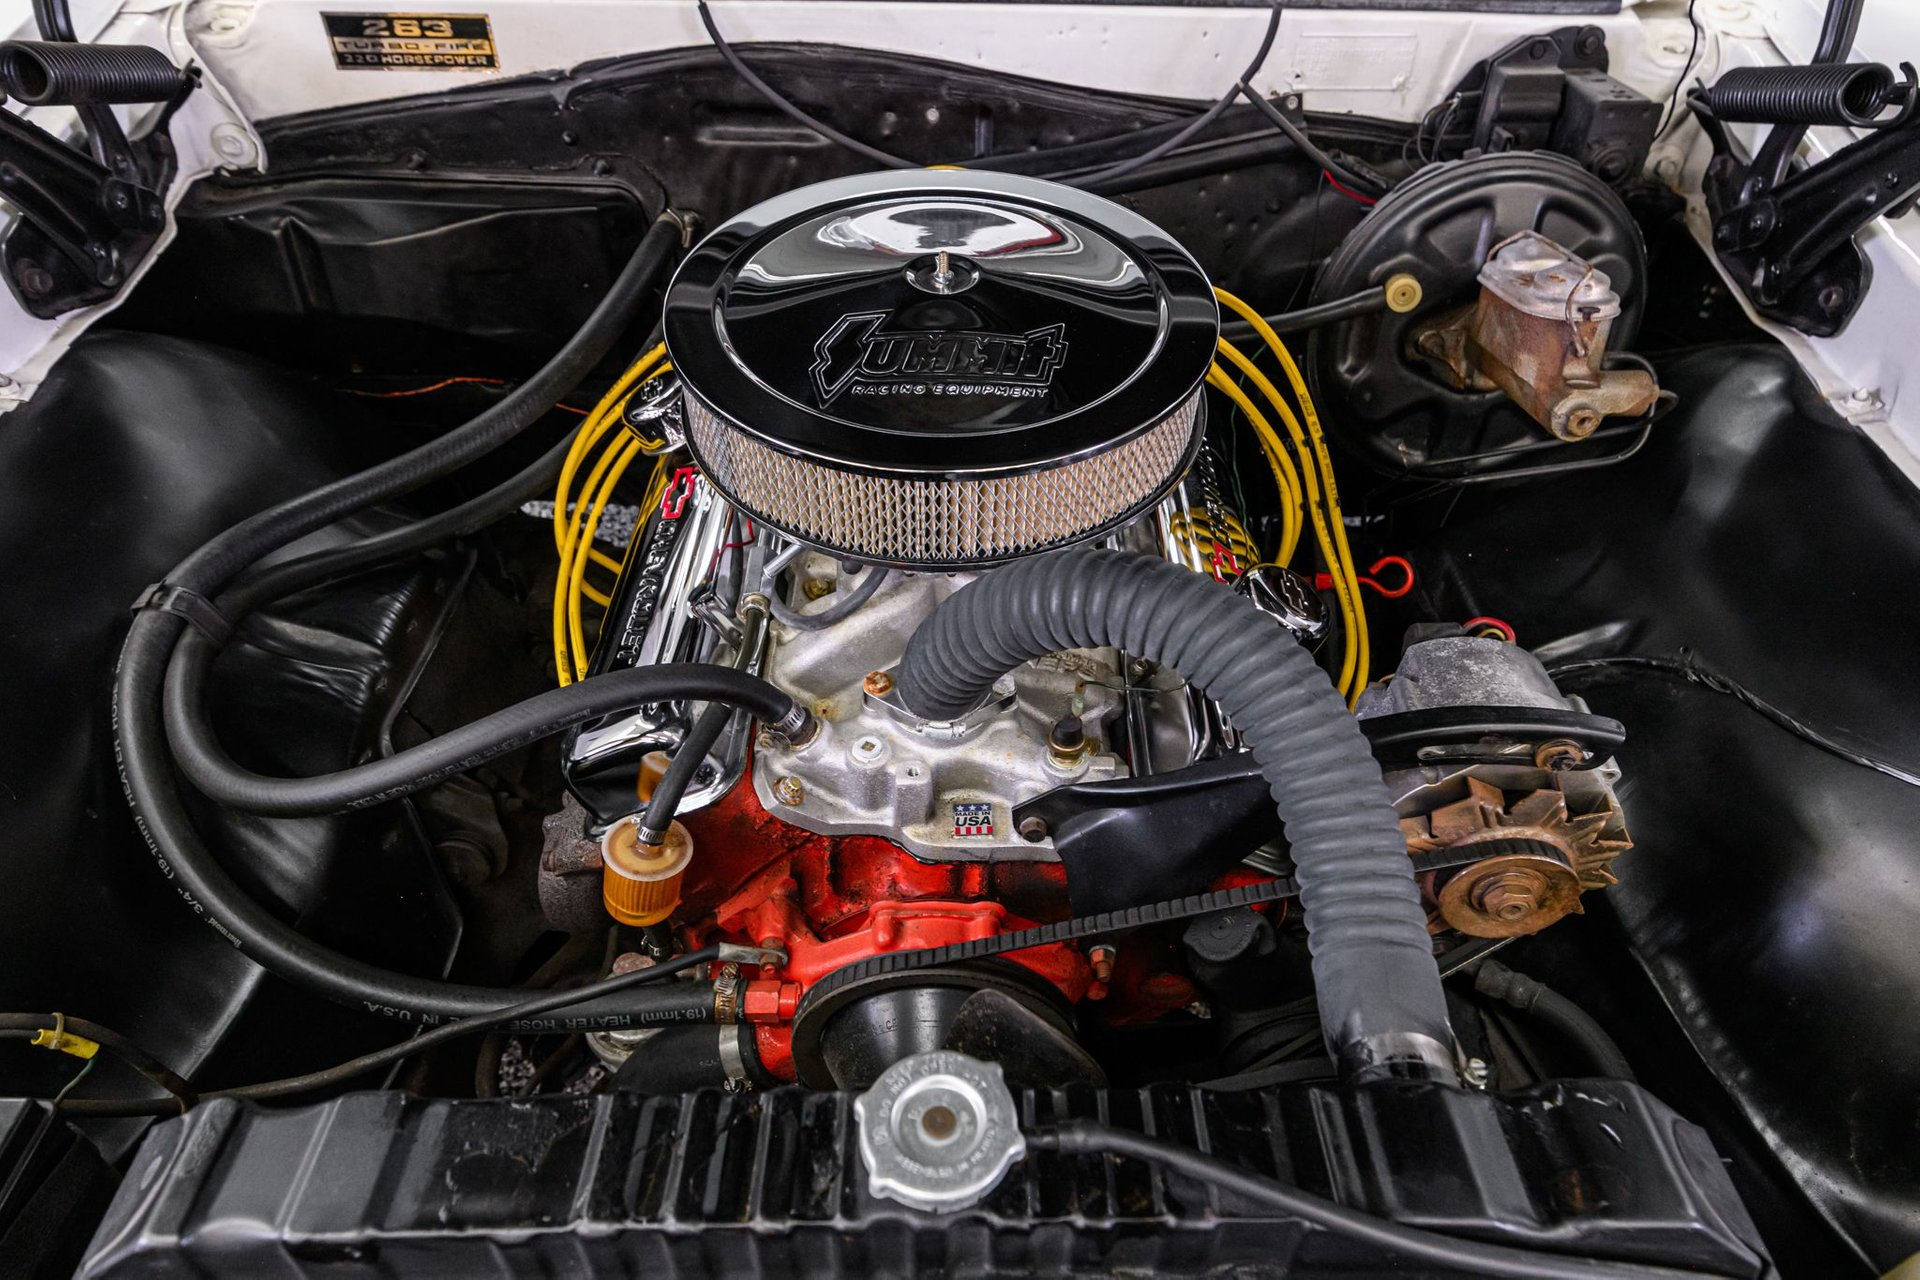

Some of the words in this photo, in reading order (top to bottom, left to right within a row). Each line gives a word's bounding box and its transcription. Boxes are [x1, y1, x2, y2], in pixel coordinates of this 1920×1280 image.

[362, 19, 454, 38] 283
[380, 54, 488, 65] HORSEPOWER
[851, 384, 926, 395] RACING
[932, 384, 1049, 397] EQUIPMENT
[616, 519, 677, 665] CHEVROLET
[111, 681, 120, 731] HOSE
[113, 738, 136, 808] HEATER
[955, 815, 991, 827] USA
[362, 1000, 411, 1020] U.S.A.
[640, 1007, 707, 1024] (19.1mm)
[422, 1013, 439, 1025] IN
[510, 1019, 555, 1032] HOSE
[566, 1014, 631, 1029] HEATER
